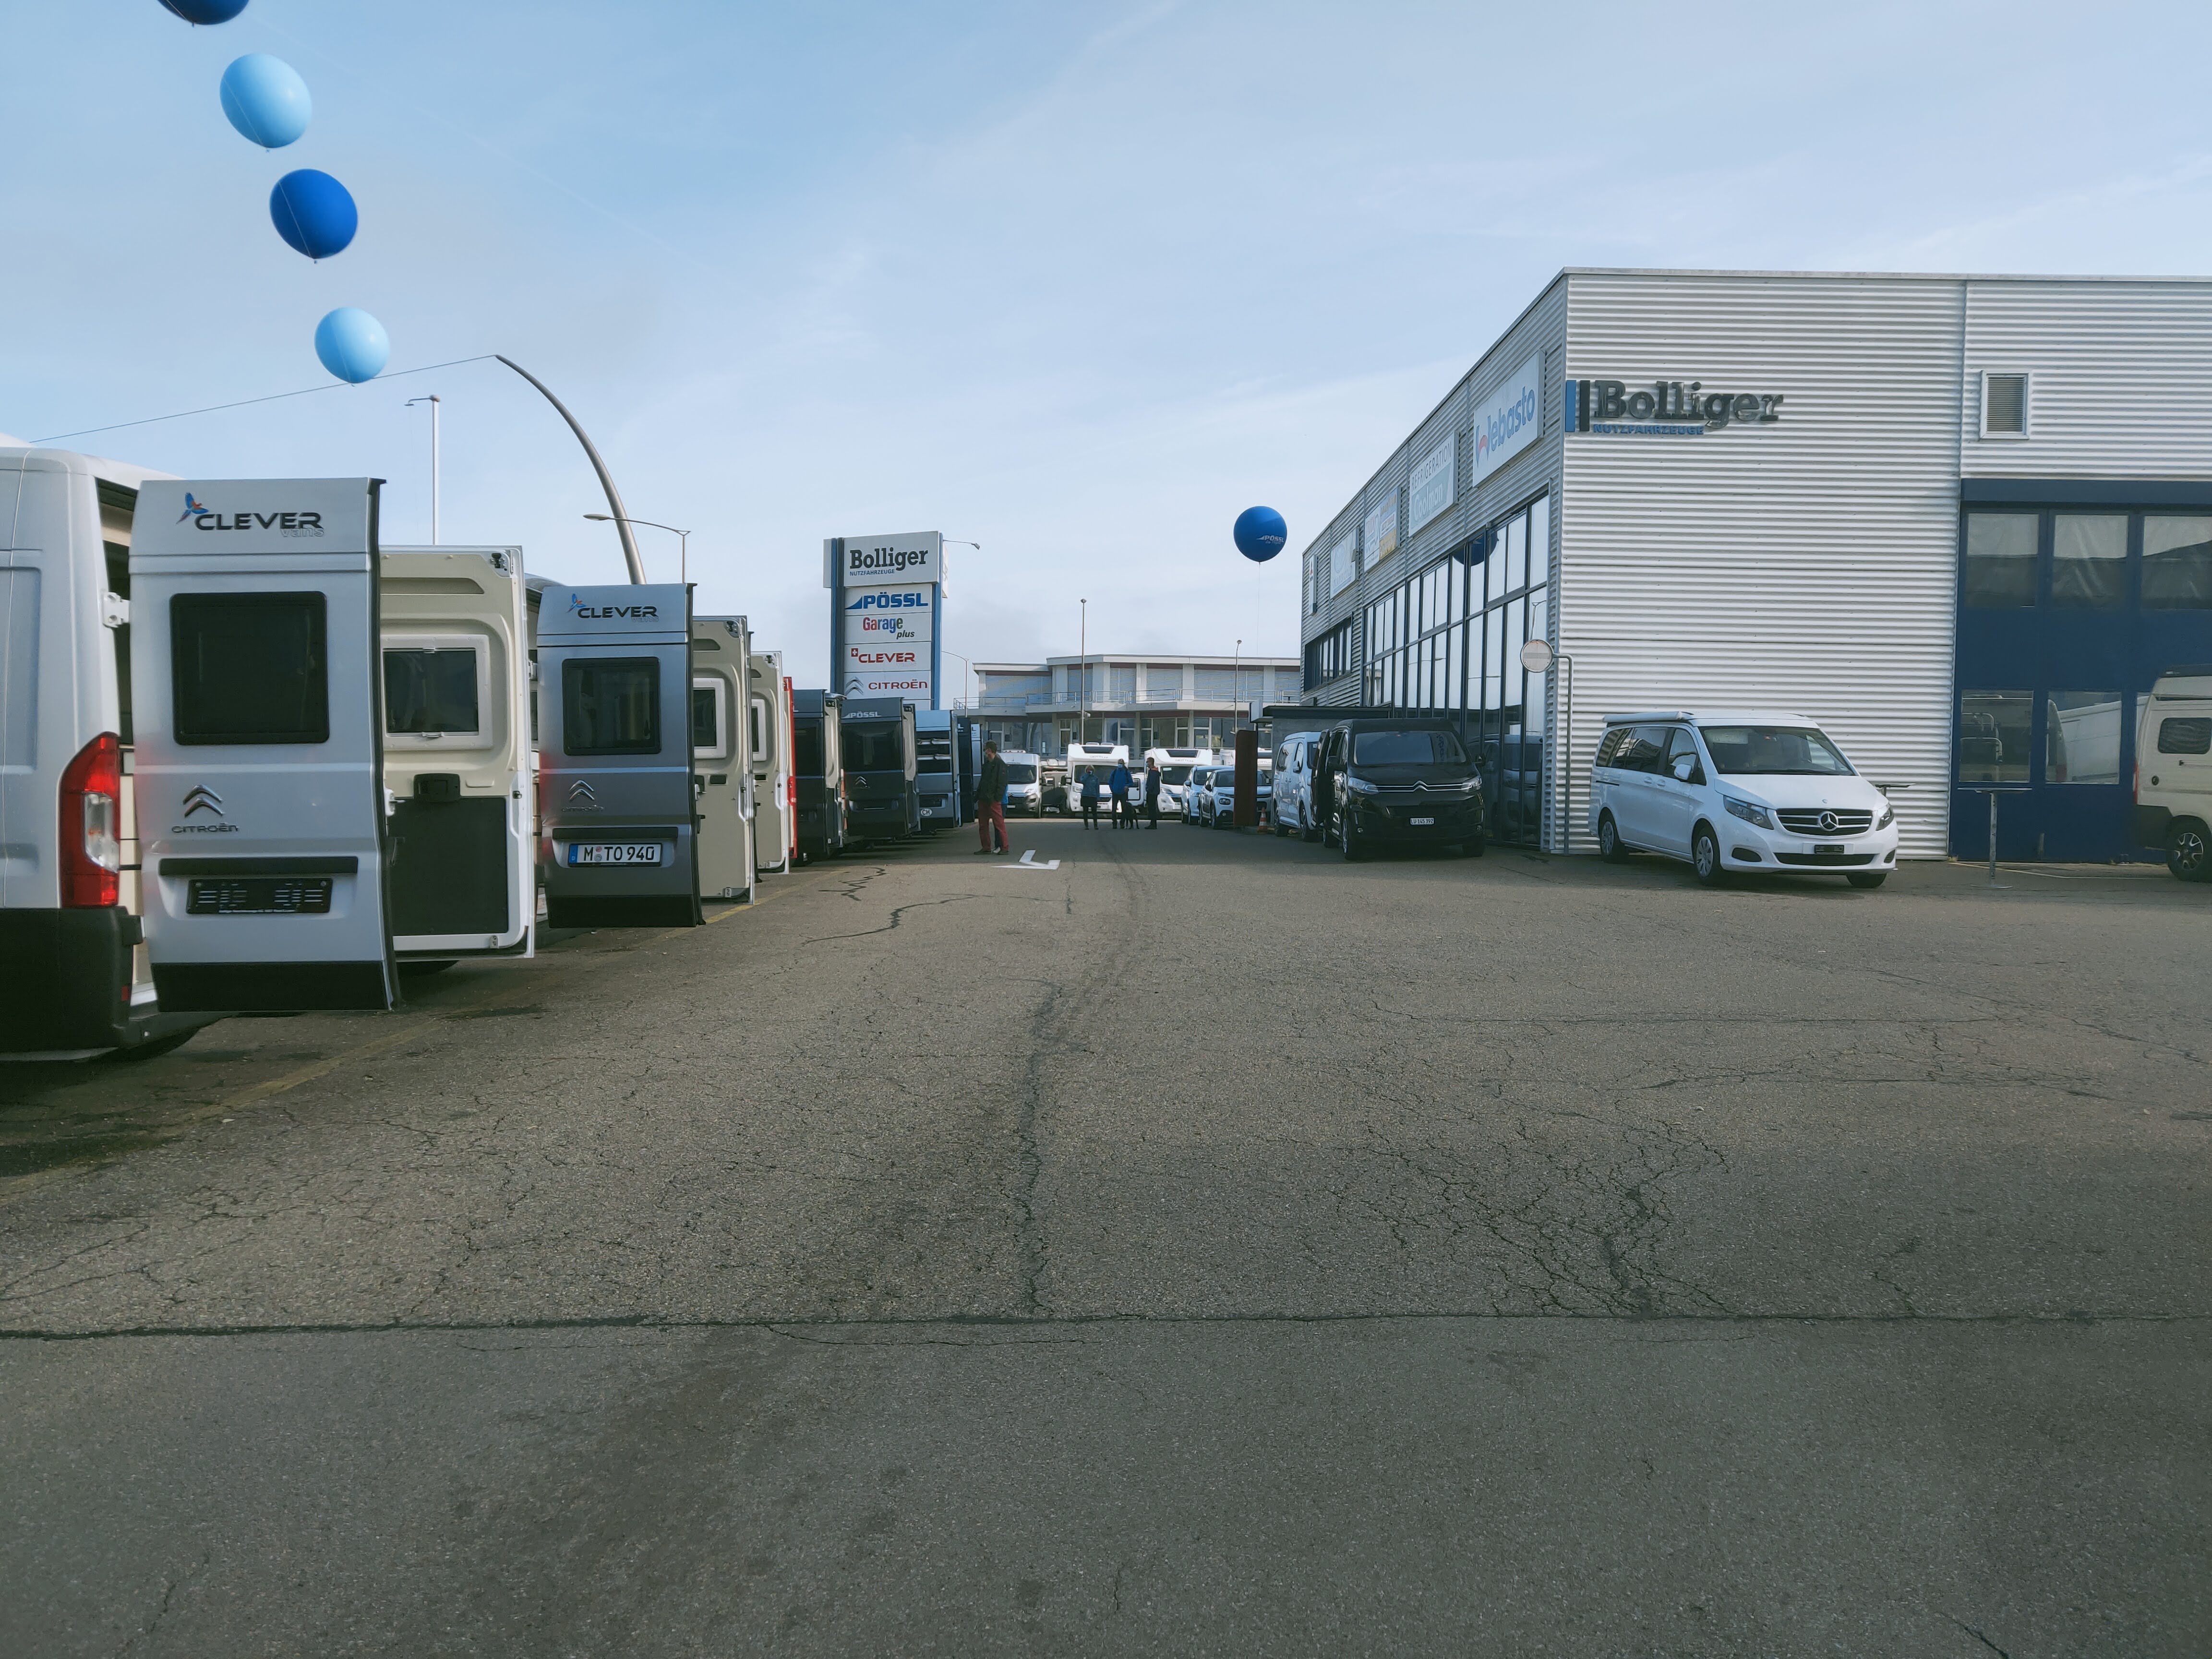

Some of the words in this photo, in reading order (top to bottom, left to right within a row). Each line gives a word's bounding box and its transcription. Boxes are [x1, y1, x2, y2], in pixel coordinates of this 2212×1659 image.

[1594, 380, 1784, 429] Bolliger
[1476, 386, 1535, 468] Webasto
[1594, 424, 1704, 435] NUTZFAHRZEUGE
[1411, 441, 1452, 491] REFRIGERATION
[1414, 483, 1443, 522] Coolman
[194, 512, 324, 530] CLEVER
[280, 528, 325, 538] vans
[850, 547, 928, 571] Bolliger
[863, 591, 928, 609] PÖSSL
[577, 606, 659, 619] CLEVER
[863, 617, 903, 634] Garage
[896, 630, 915, 640] plus
[858, 652, 915, 663] CLEVER
[584, 847, 593, 861] M
[604, 846, 623, 861] TO
[627, 846, 654, 861] 940
